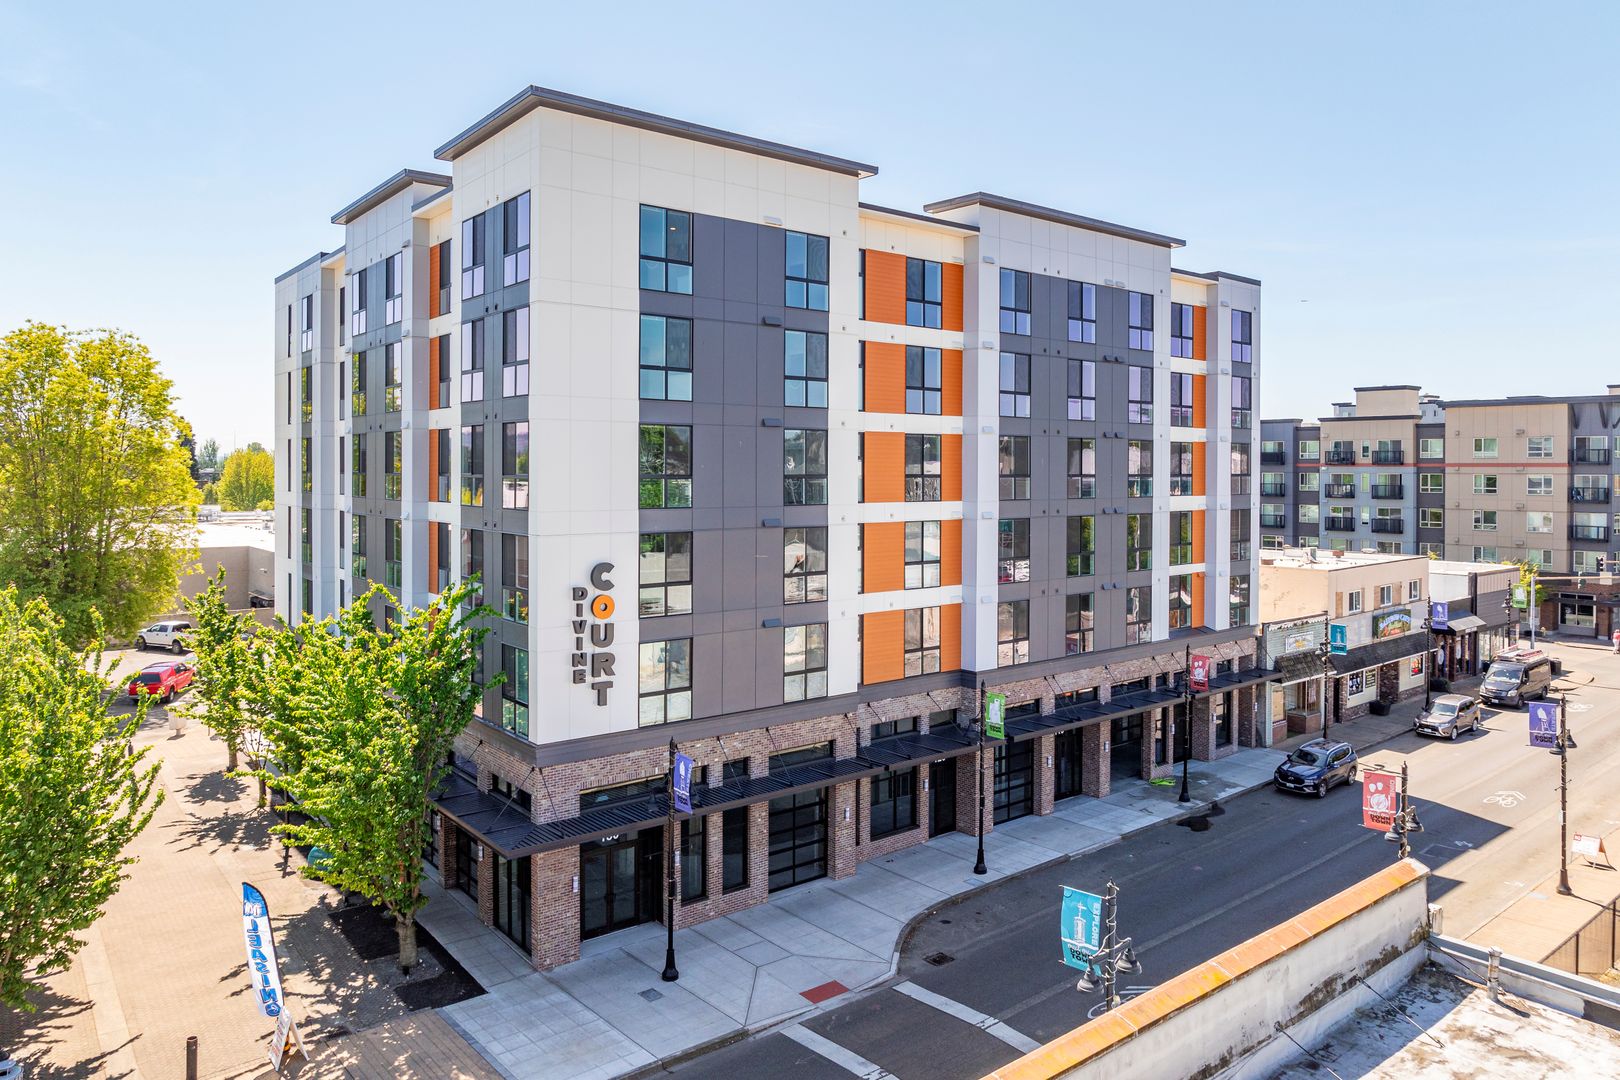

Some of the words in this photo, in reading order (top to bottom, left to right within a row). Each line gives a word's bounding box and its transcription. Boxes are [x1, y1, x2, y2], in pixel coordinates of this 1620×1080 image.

[572, 587, 588, 684] DIVINE
[590, 562, 616, 706] COURT
[1091, 902, 1101, 946] EXPLORE
